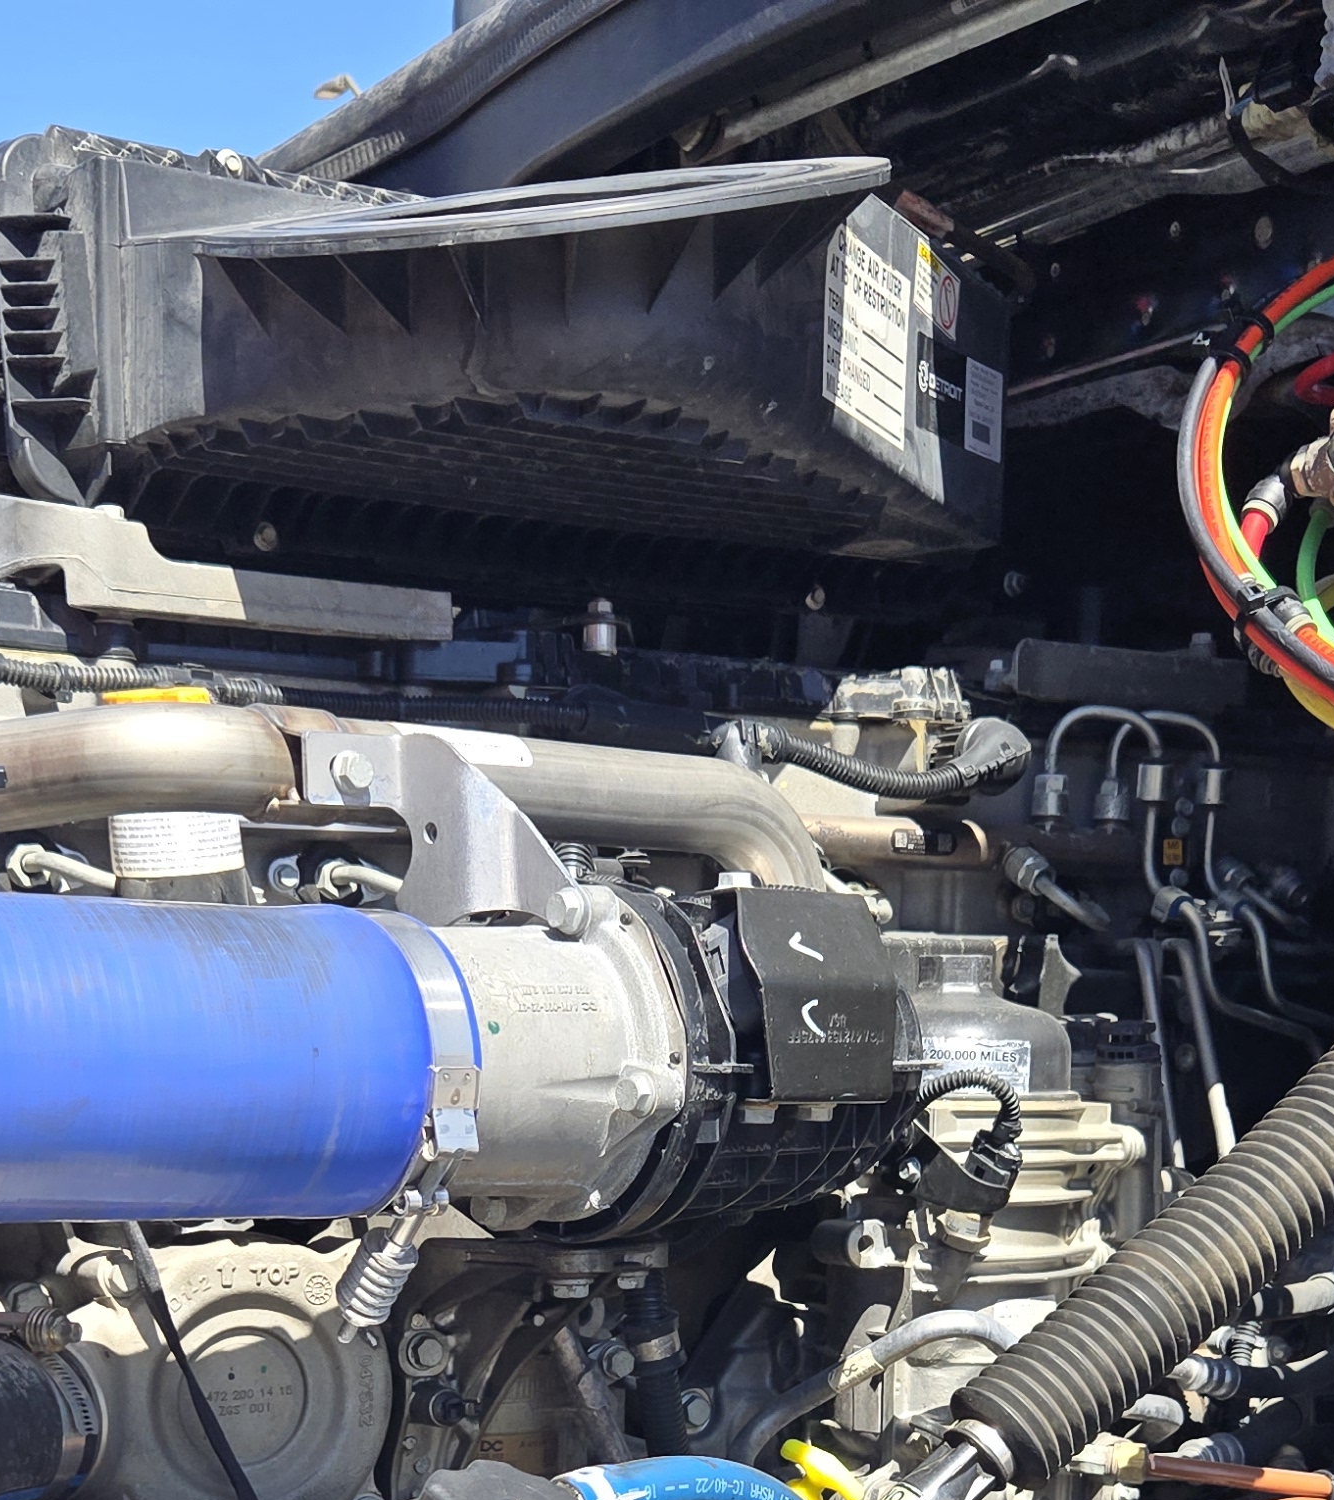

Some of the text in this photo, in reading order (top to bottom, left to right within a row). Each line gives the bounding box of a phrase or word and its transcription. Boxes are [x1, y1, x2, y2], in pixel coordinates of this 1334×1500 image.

[868, 259, 879, 281] AIR
[882, 270, 902, 297] FILTER
[830, 253, 840, 276] AT
[853, 277, 862, 299] OF
[863, 281, 906, 333] RESTRICTION
[826, 345, 870, 392] DATE CHANGED
[929, 373, 963, 401] DETROIT
[930, 1050, 1017, 1063] 200,000 MILES
[249, 1262, 301, 1286] TOP
[480, 1441, 503, 1452] DC
[695, 1477, 744, 1492] IC-40/22
